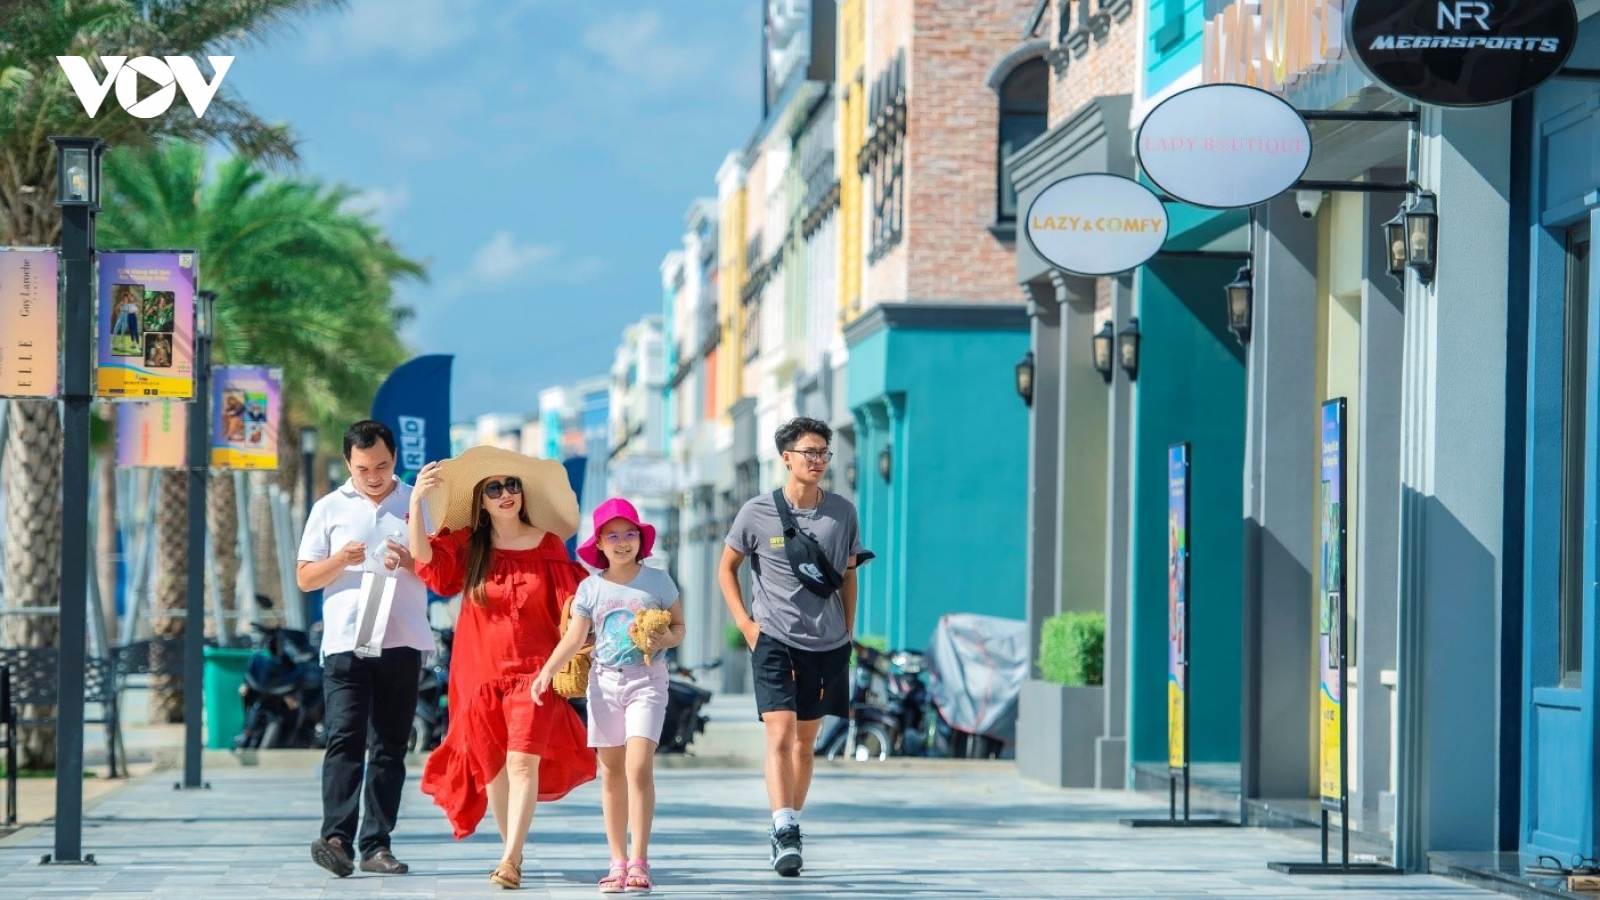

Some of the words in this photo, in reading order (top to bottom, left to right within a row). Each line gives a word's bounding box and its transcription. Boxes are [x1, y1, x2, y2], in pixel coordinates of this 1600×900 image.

[1436, 0, 1491, 31] NFR
[1369, 35, 1560, 53] MEGASPORTS
[1144, 137, 1195, 152] LADY
[1032, 215, 1080, 231] LAZY
[1083, 220, 1093, 232] &
[1095, 216, 1162, 233] COMFY
[19, 259, 31, 296] Laroche
[19, 299, 32, 317] Guy
[17, 341, 33, 387] ELLE
